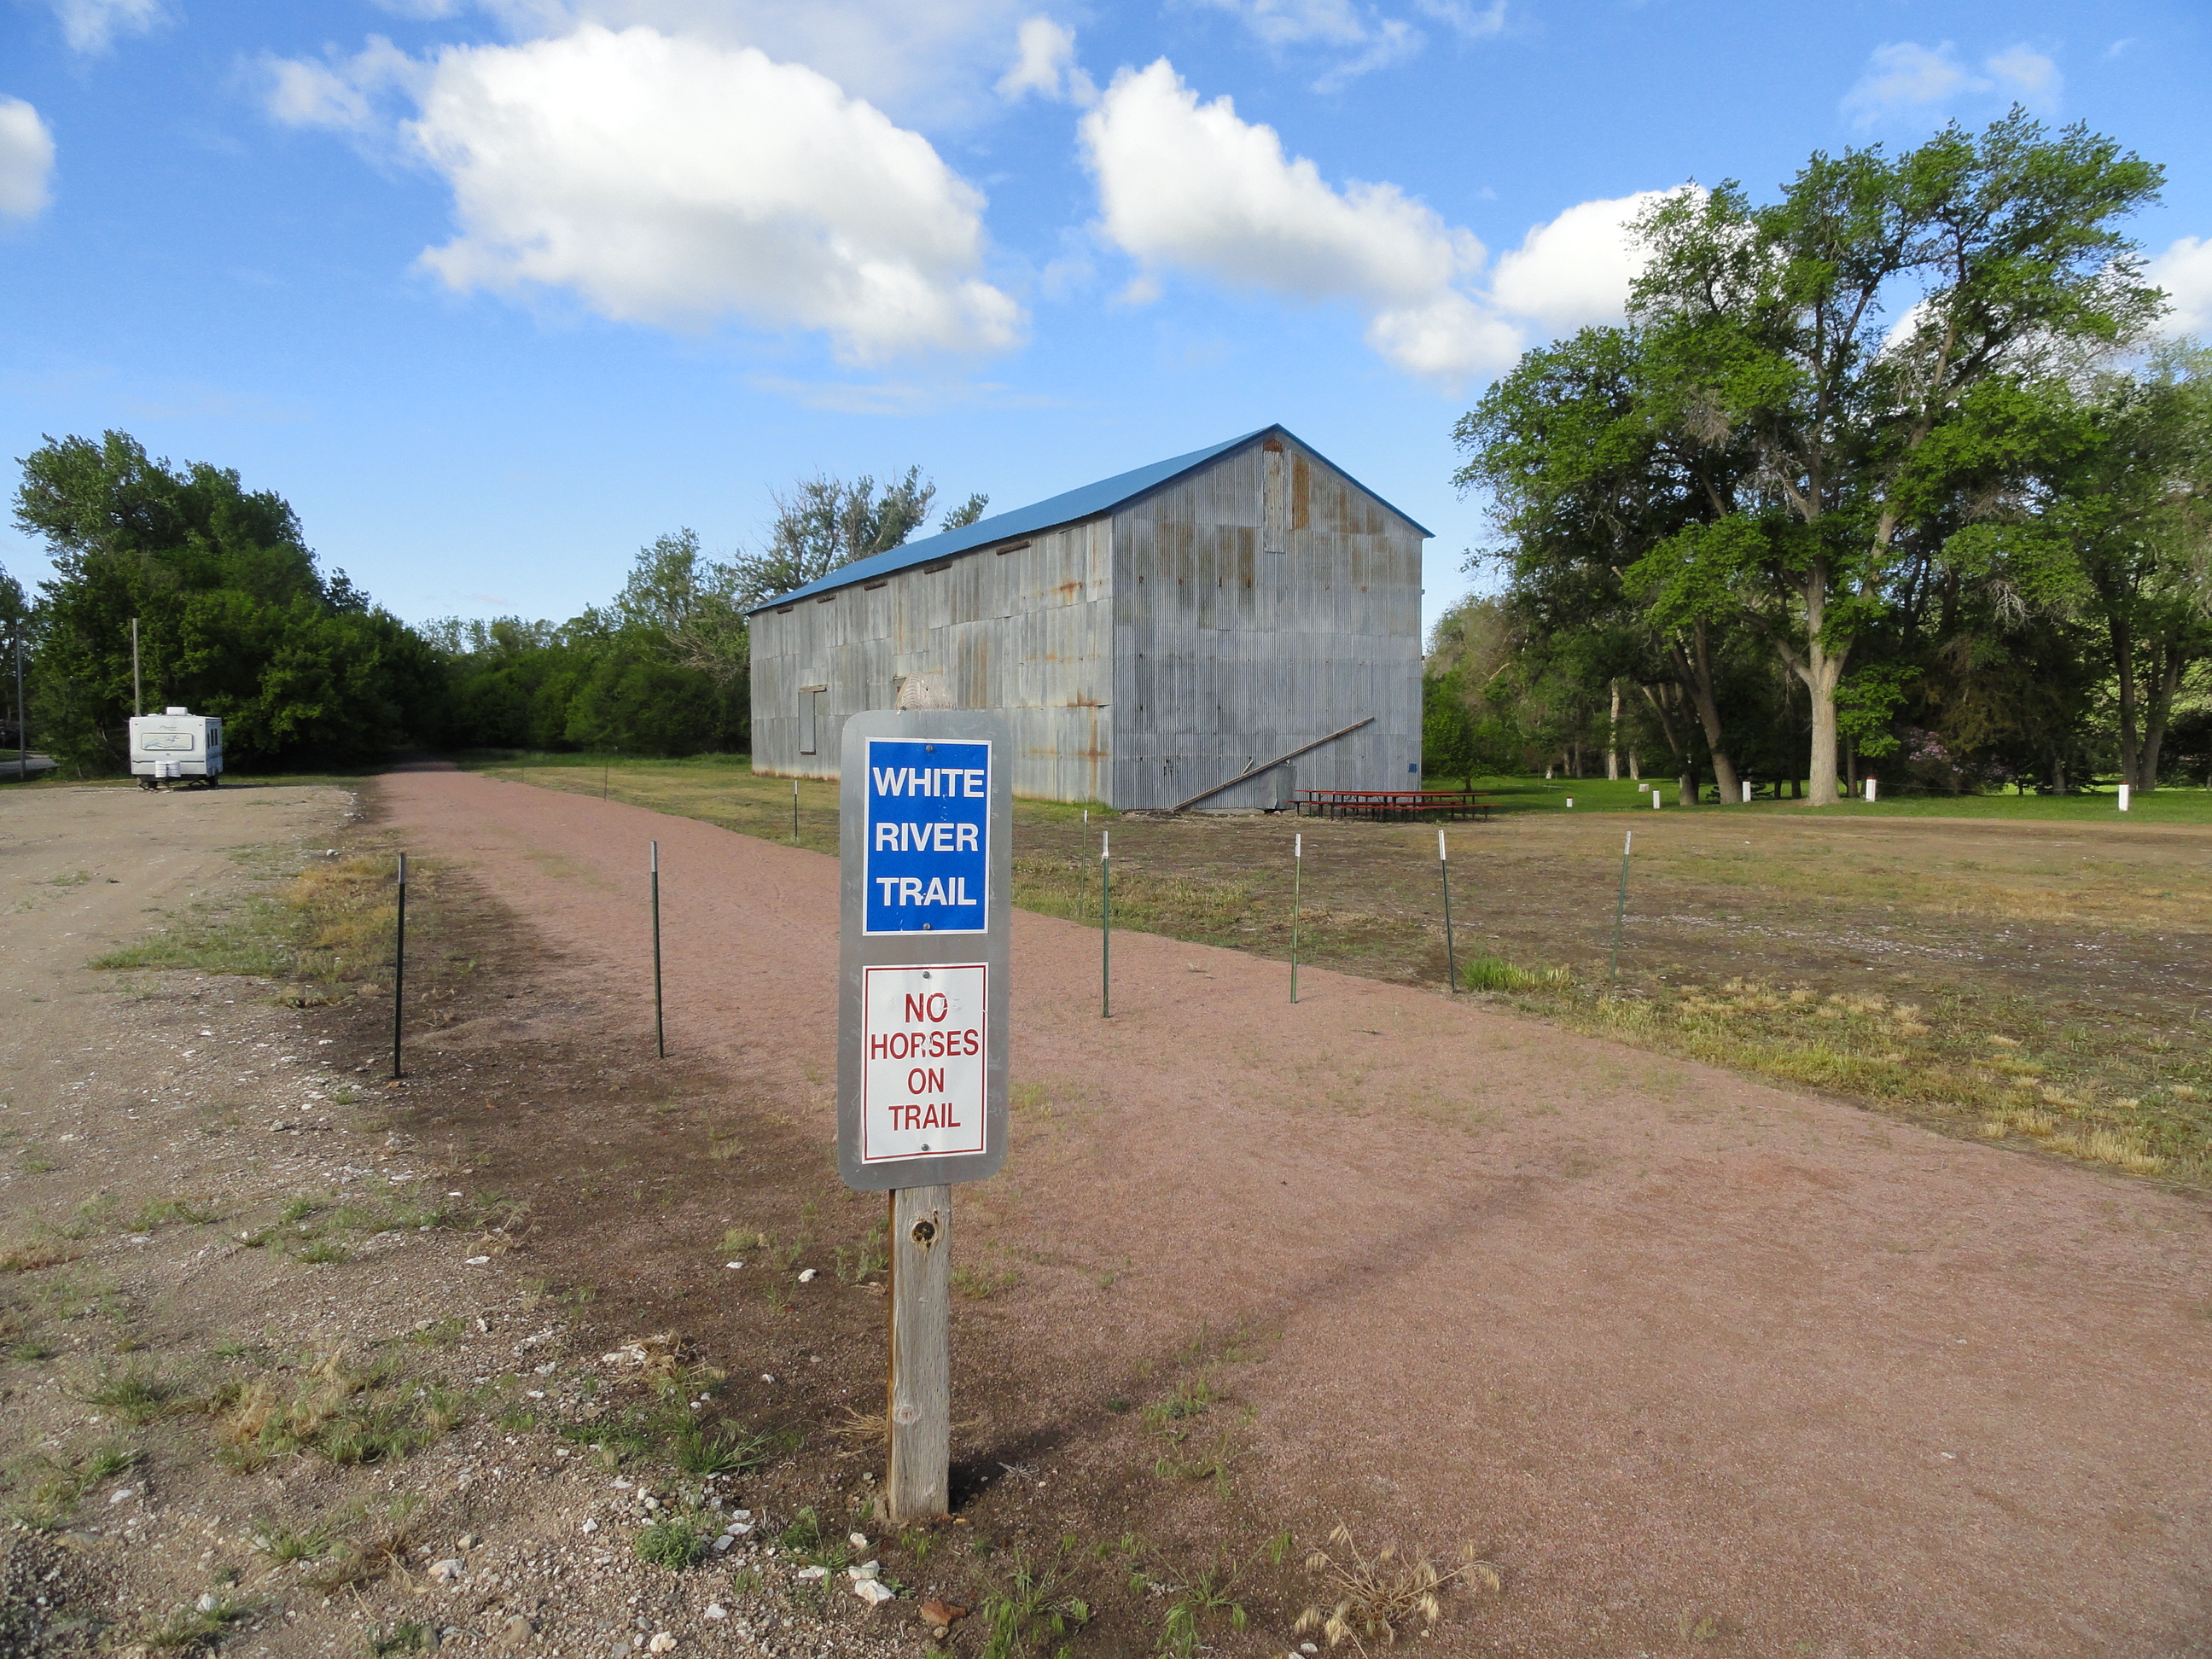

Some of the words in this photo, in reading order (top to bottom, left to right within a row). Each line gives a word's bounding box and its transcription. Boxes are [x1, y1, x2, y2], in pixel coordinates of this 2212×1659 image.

[872, 766, 985, 798] WHITE
[876, 822, 979, 852] RIVER
[876, 876, 977, 906] TRAIL
[905, 992, 948, 1023] NO
[870, 1028, 979, 1060] HORSES
[907, 1067, 945, 1095] ON
[888, 1102, 961, 1131] TRAIL
